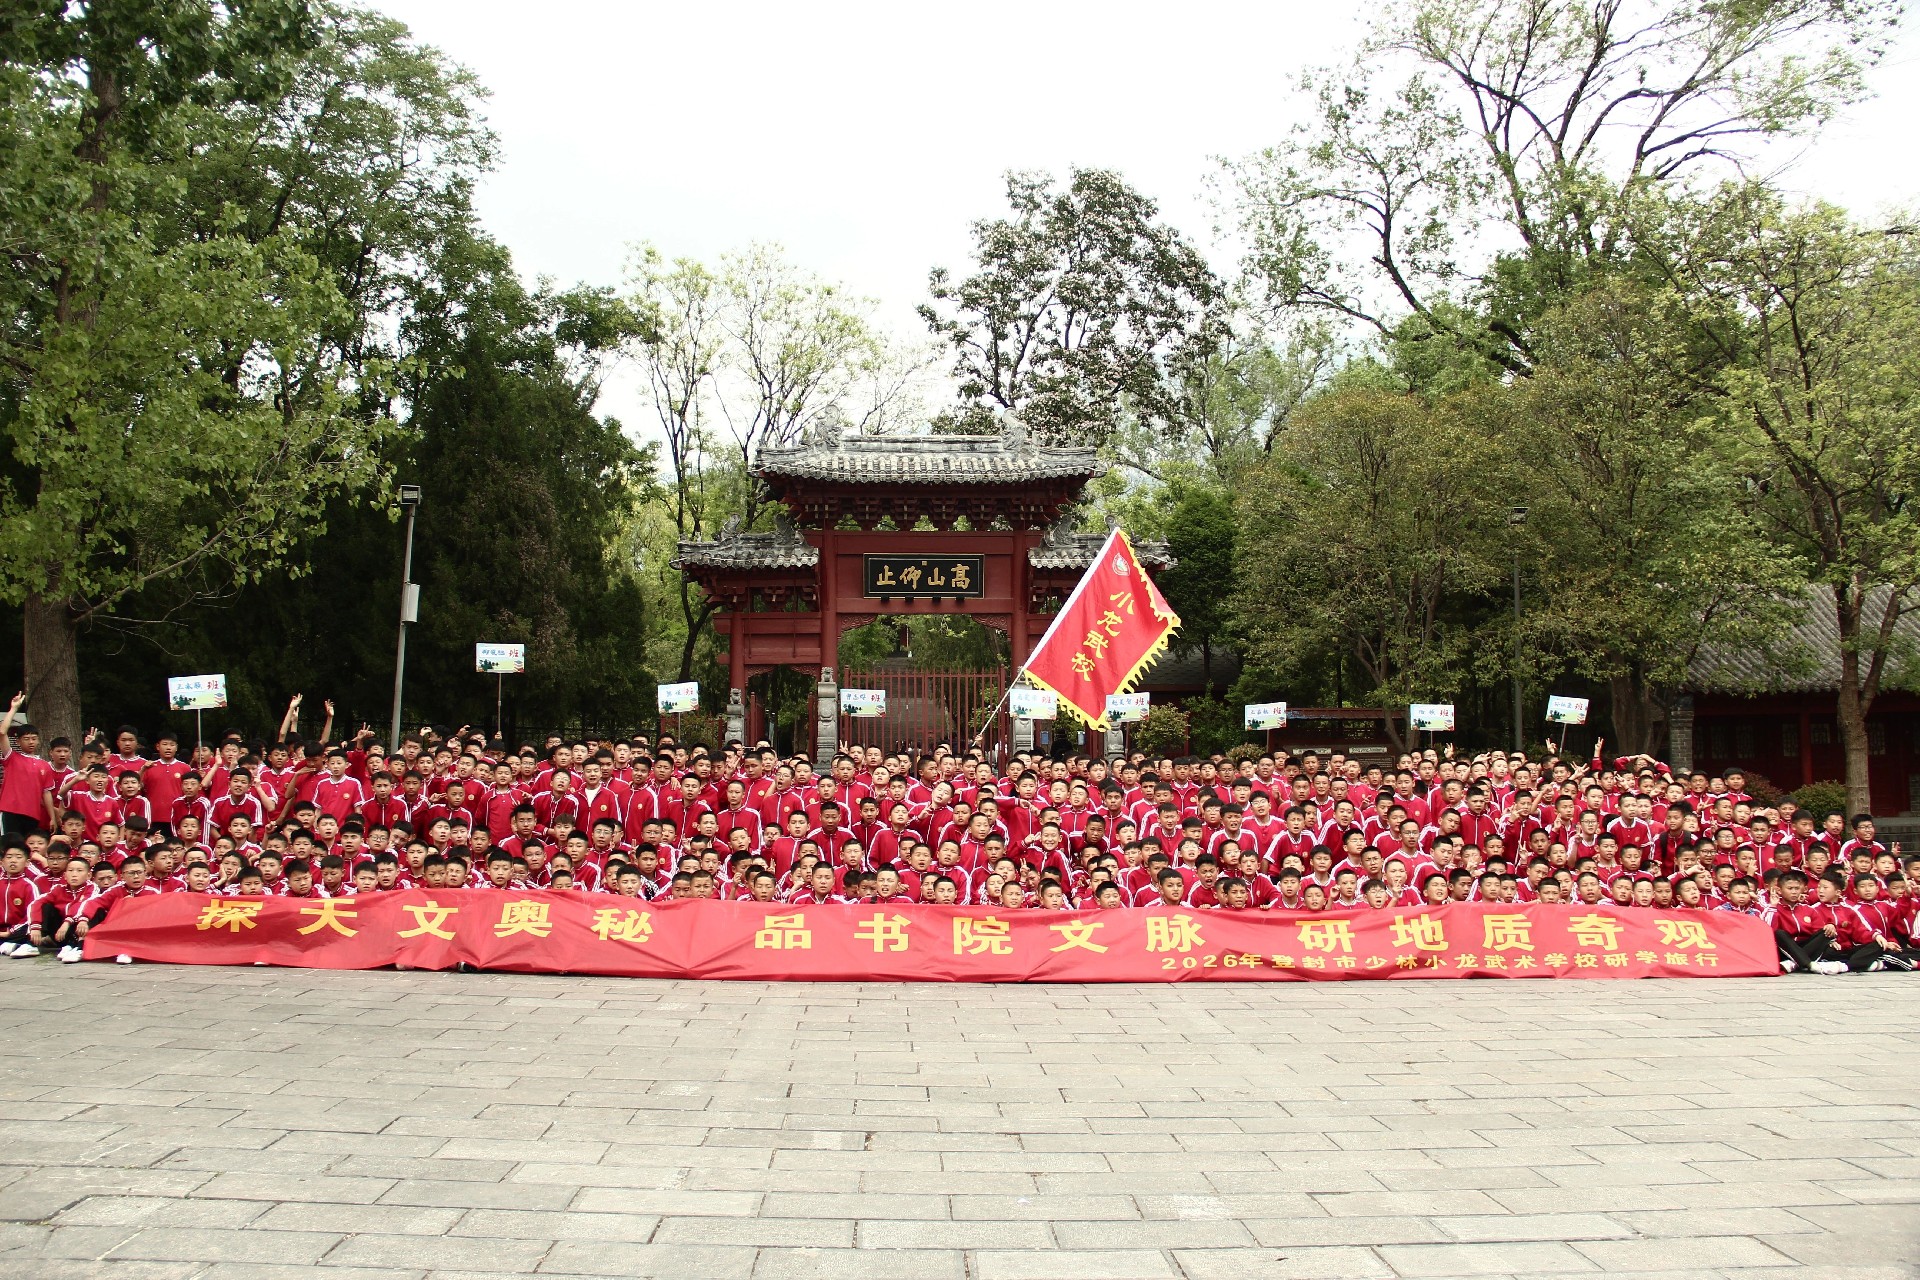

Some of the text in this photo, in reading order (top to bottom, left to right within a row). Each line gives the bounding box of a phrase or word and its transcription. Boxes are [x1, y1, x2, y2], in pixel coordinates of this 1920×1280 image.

[1071, 591, 1135, 682] 小龙武校
[195, 898, 1717, 955] 探天文奥秘 品书院文脉 研地质奇观
[1161, 950, 1719, 970] 2026年登封市少林小龙武术学校研学旅行
